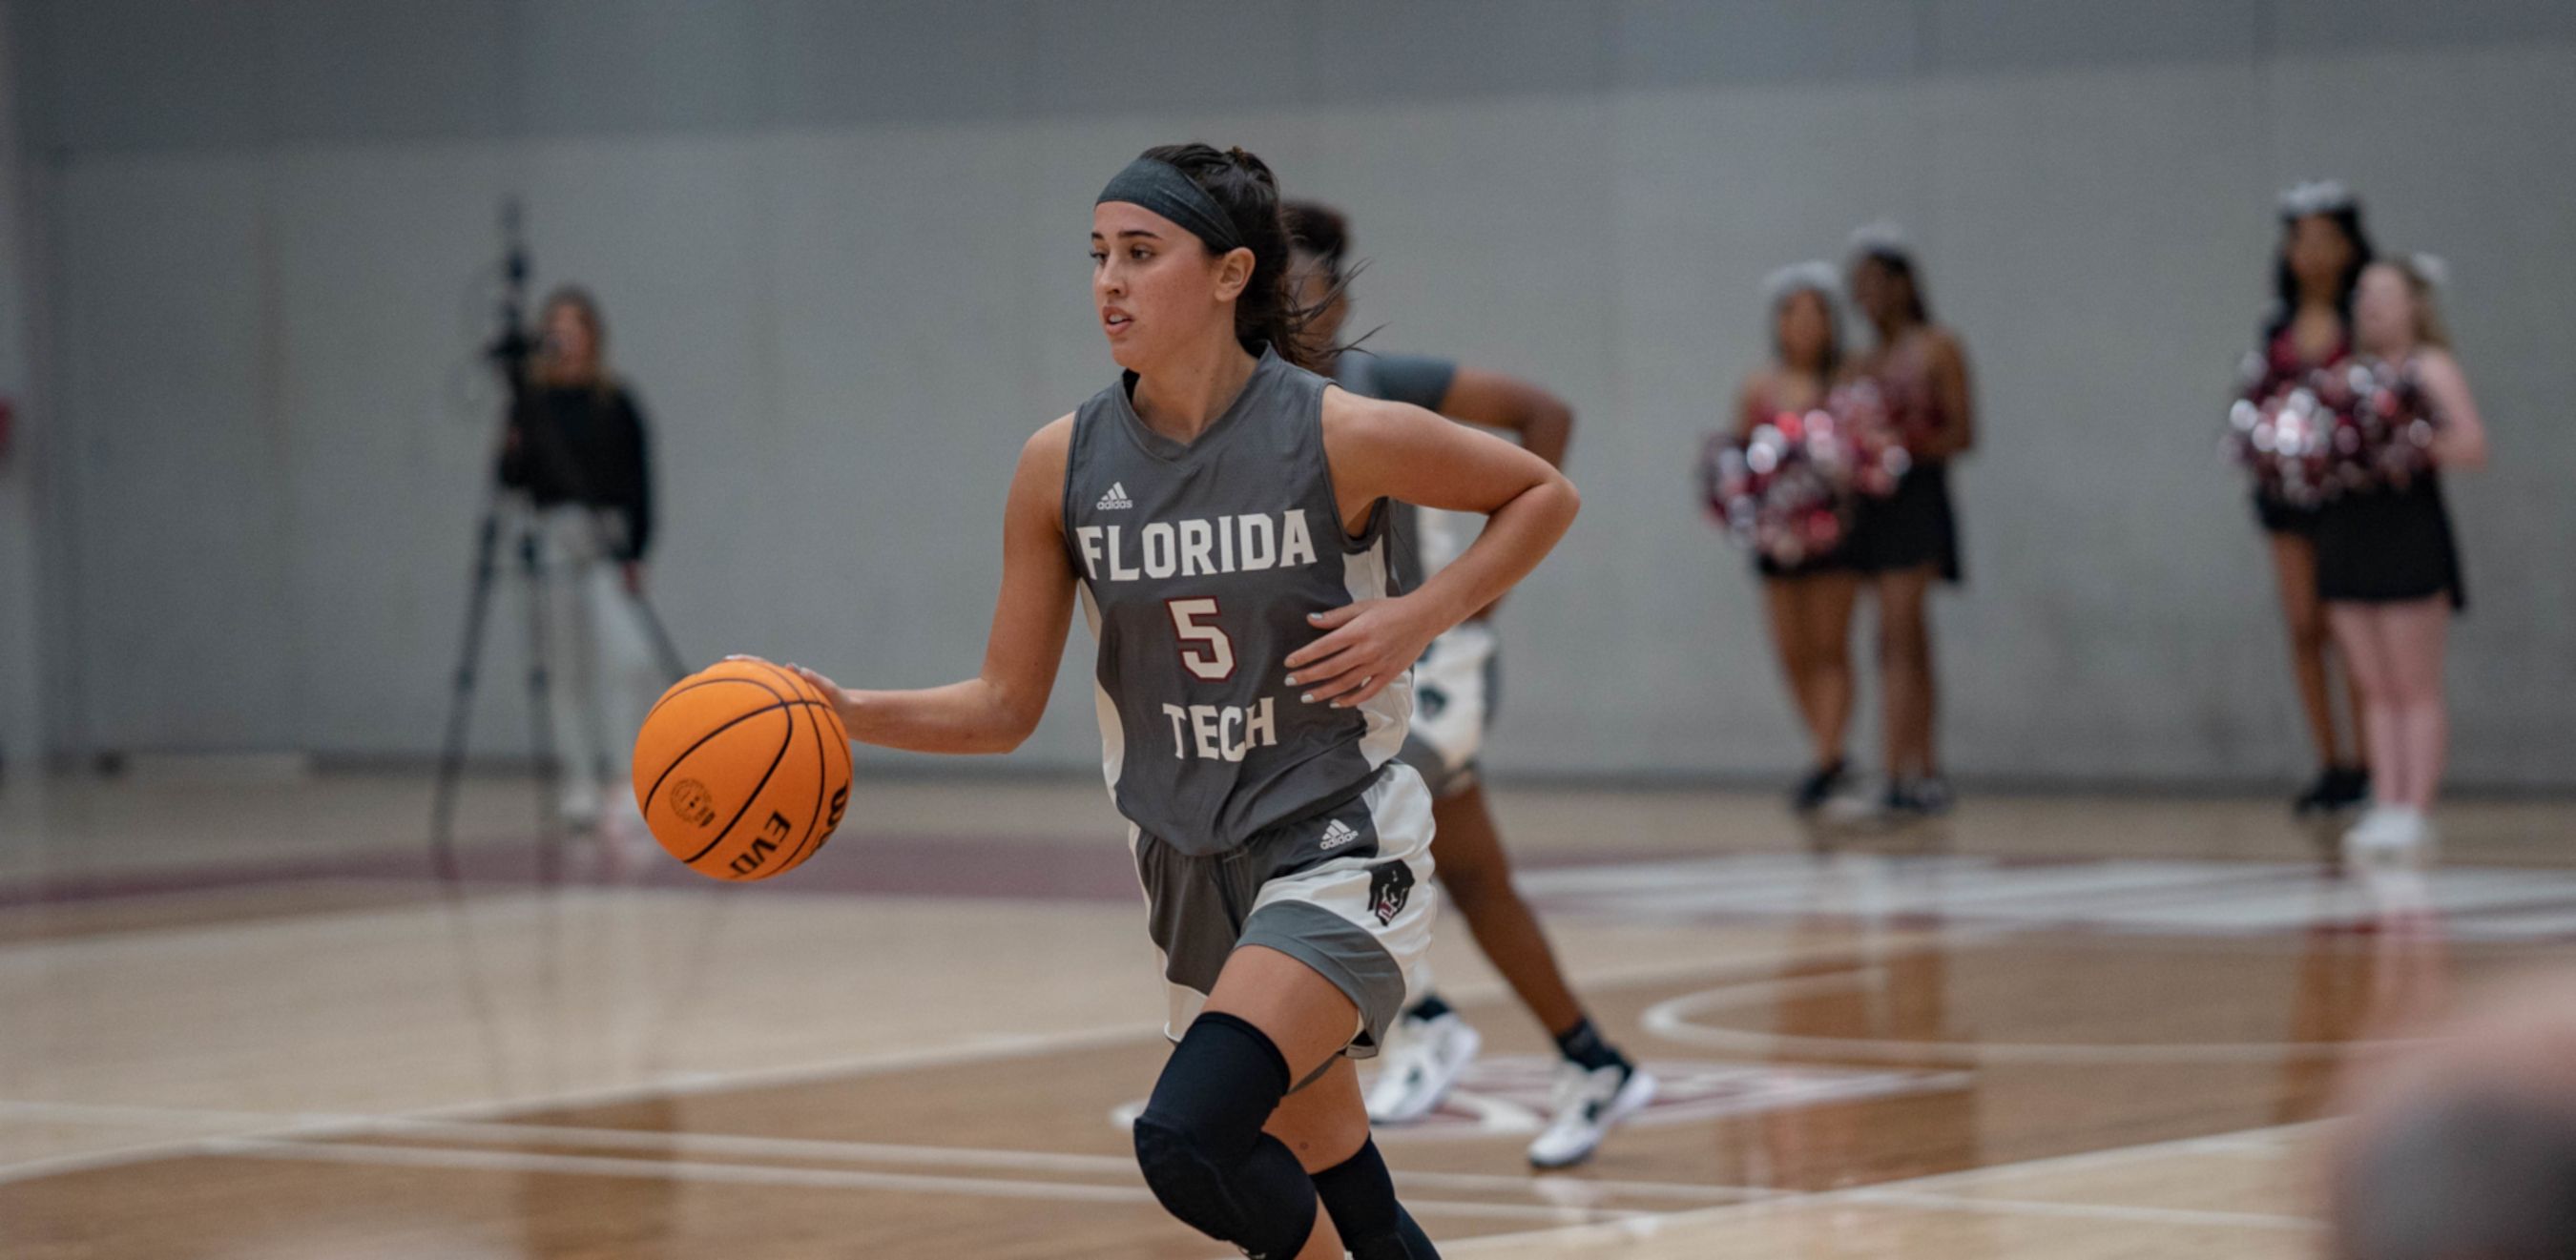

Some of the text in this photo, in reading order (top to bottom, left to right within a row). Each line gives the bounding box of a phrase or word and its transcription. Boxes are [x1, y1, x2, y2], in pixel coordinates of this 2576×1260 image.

[1096, 498, 1133, 510] adidas
[1075, 508, 1318, 581] FLORIDA
[1165, 595, 1237, 683] 5
[1162, 696, 1278, 762] TECH
[1319, 830, 1359, 850] adidas
